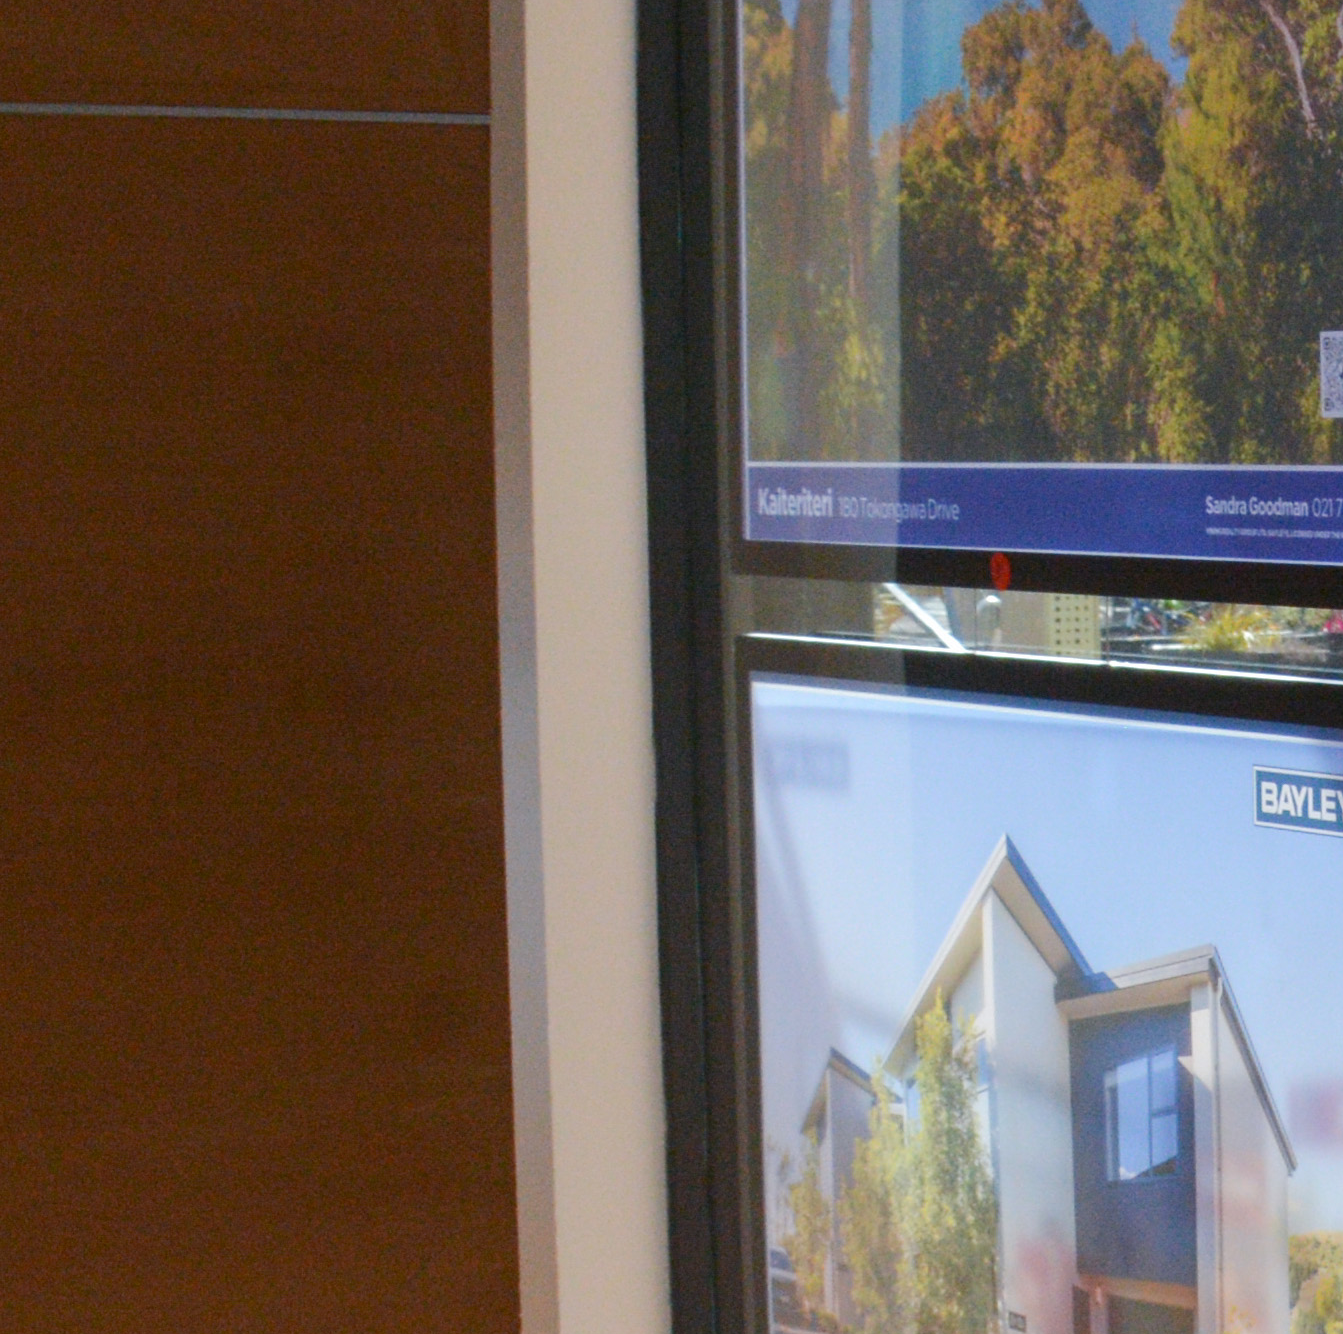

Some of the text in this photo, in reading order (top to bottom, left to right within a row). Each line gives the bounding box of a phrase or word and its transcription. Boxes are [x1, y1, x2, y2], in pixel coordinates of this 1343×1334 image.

[758, 487, 833, 517] Kaiteriteri
[928, 498, 960, 522] Drive
[1206, 495, 1248, 515] Sandra
[1249, 497, 1309, 517] Goodman
